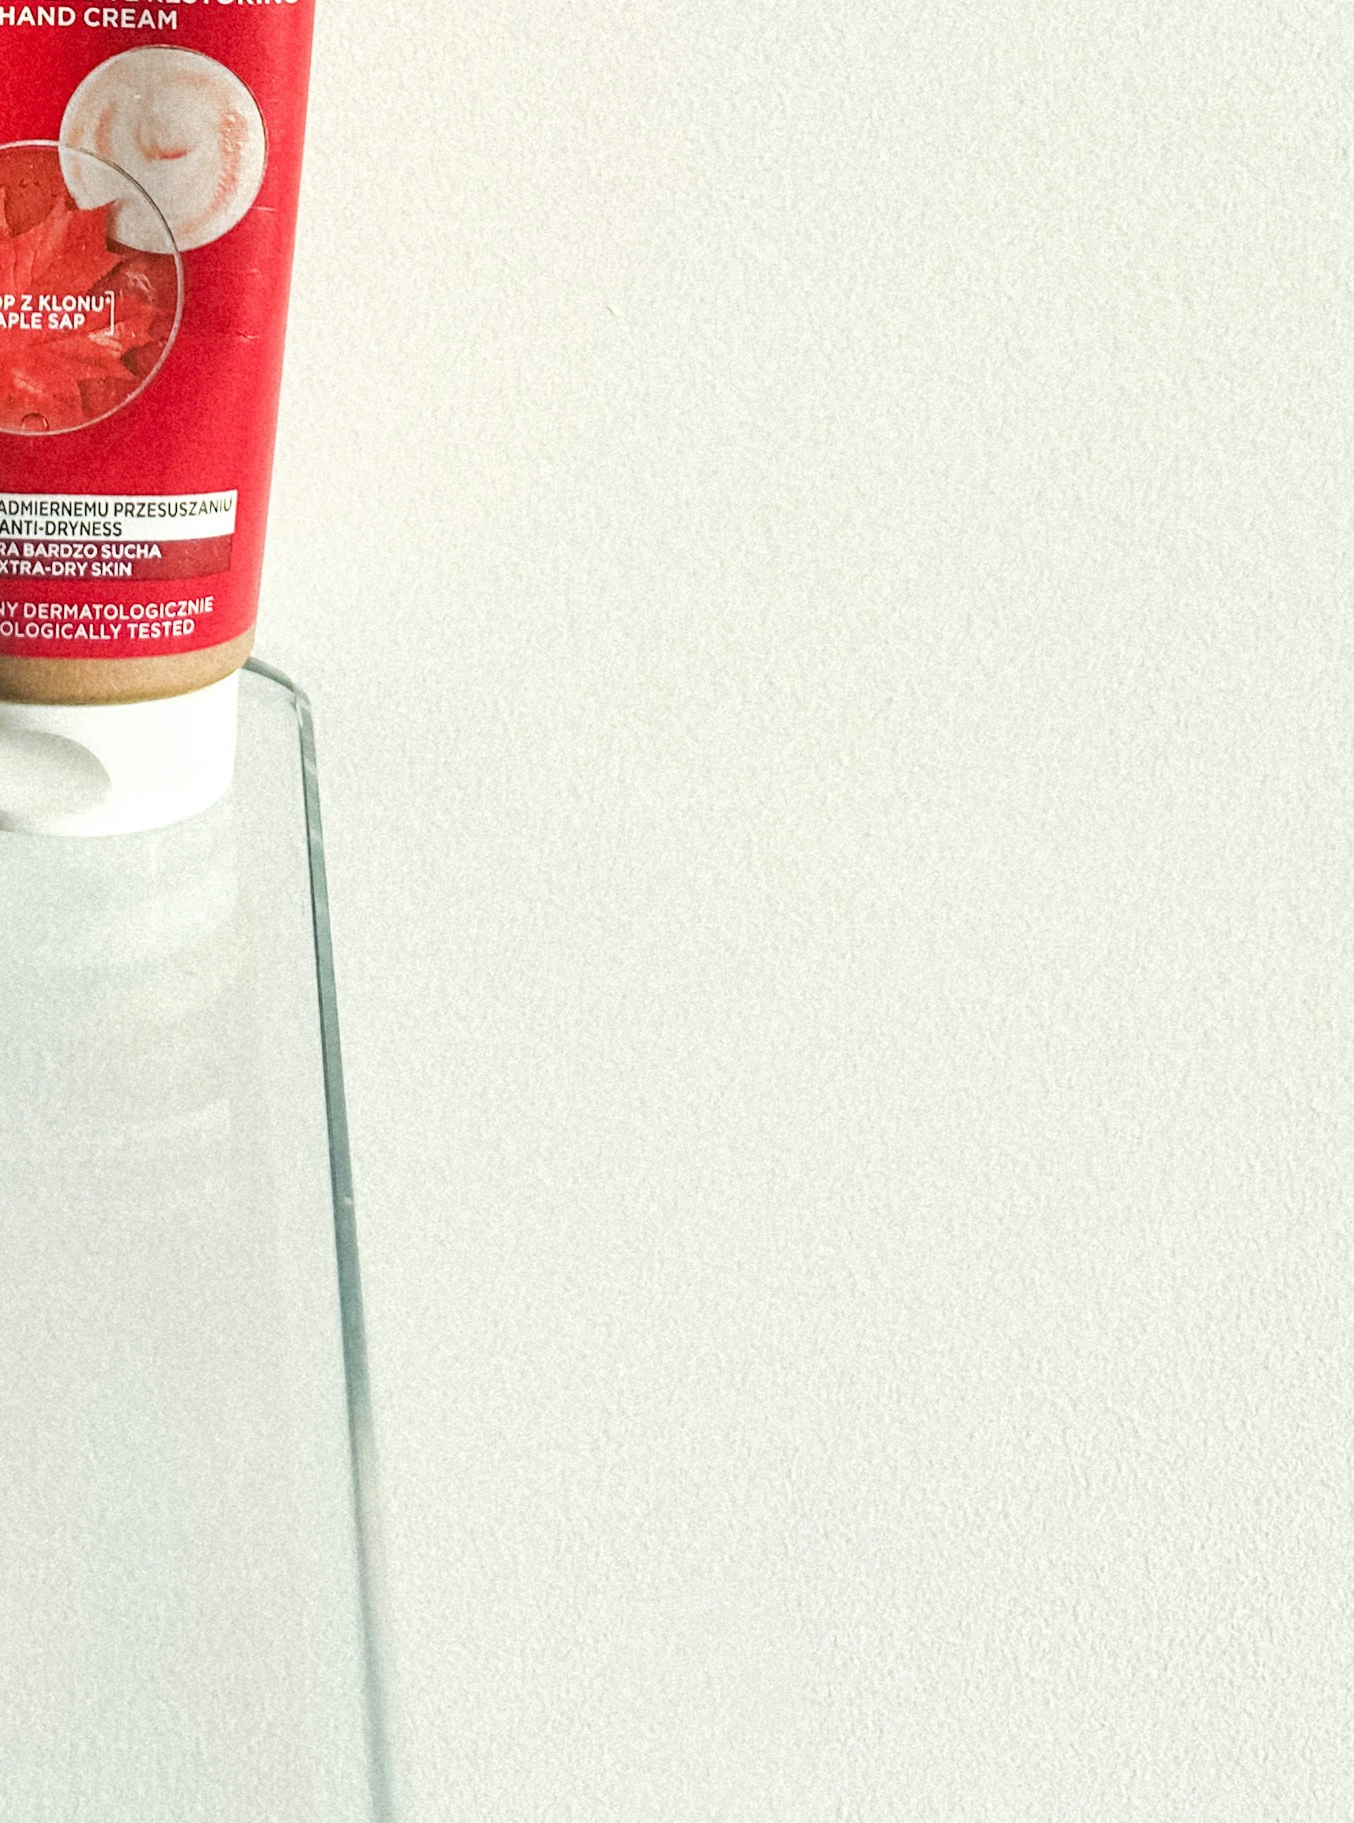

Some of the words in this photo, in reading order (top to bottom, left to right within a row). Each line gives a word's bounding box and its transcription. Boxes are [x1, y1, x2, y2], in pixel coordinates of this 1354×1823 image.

[0, 7, 76, 28] HAND
[83, 8, 178, 30] CREAM
[21, 294, 33, 311] Z
[48, 312, 86, 330] SAP
[114, 497, 234, 518] PRZESUSZANIU
[23, 542, 98, 558] BARDZO
[101, 543, 162, 558] SUCHA
[91, 560, 133, 577] SKIN
[23, 596, 215, 619] DERMATOLOGICZNIE
[124, 618, 196, 639] TESTED
